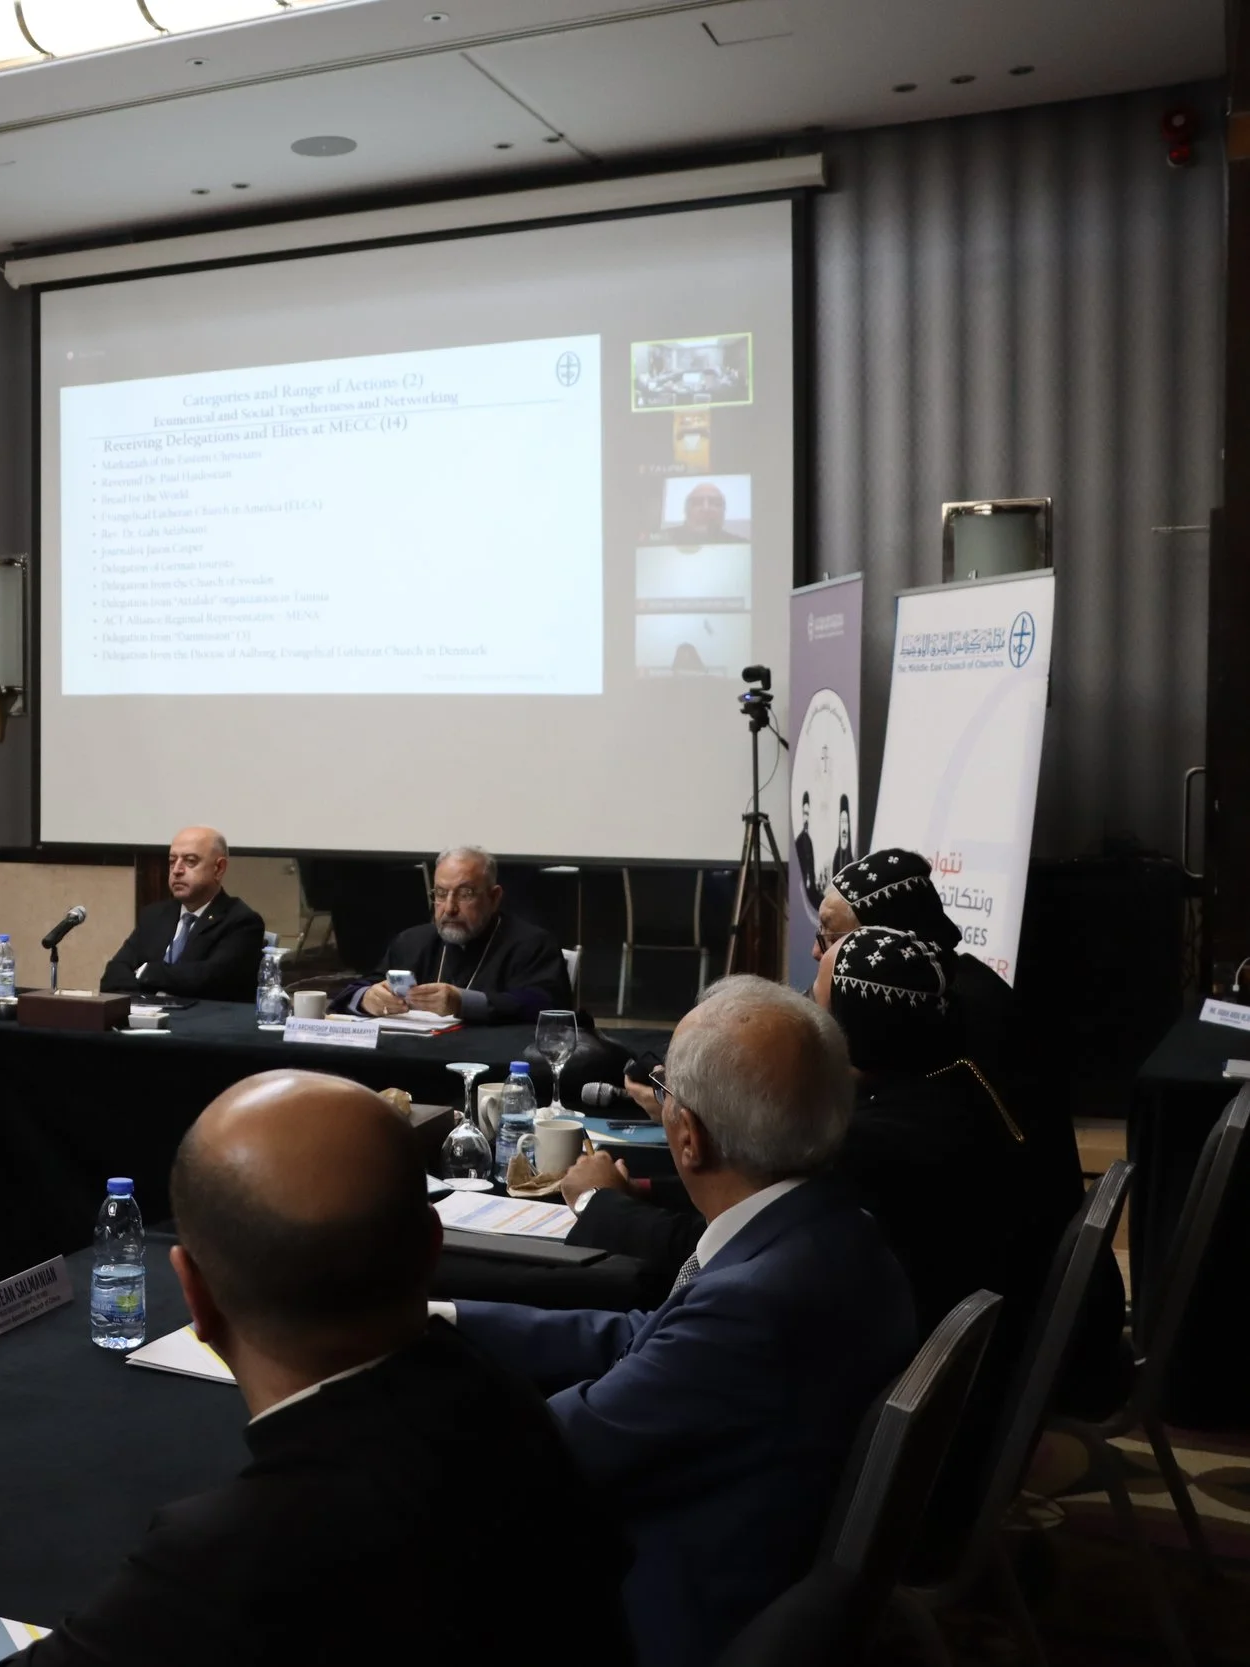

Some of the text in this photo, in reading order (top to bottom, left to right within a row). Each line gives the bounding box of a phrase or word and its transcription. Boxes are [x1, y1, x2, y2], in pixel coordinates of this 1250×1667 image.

[183, 372, 425, 408] Categories and Range of Actions (2)
[153, 391, 459, 428] Ecumenical and Social Togetherness and Networking
[104, 414, 408, 453] Receiving Delegations and Elites at MECC (14)
[908, 663, 928, 673] Middle
[930, 663, 942, 672] East
[944, 661, 966, 671] Council
[967, 661, 973, 670] of
[975, 659, 1004, 669] Churches
[14, 1266, 58, 1298] SALMANIAN
